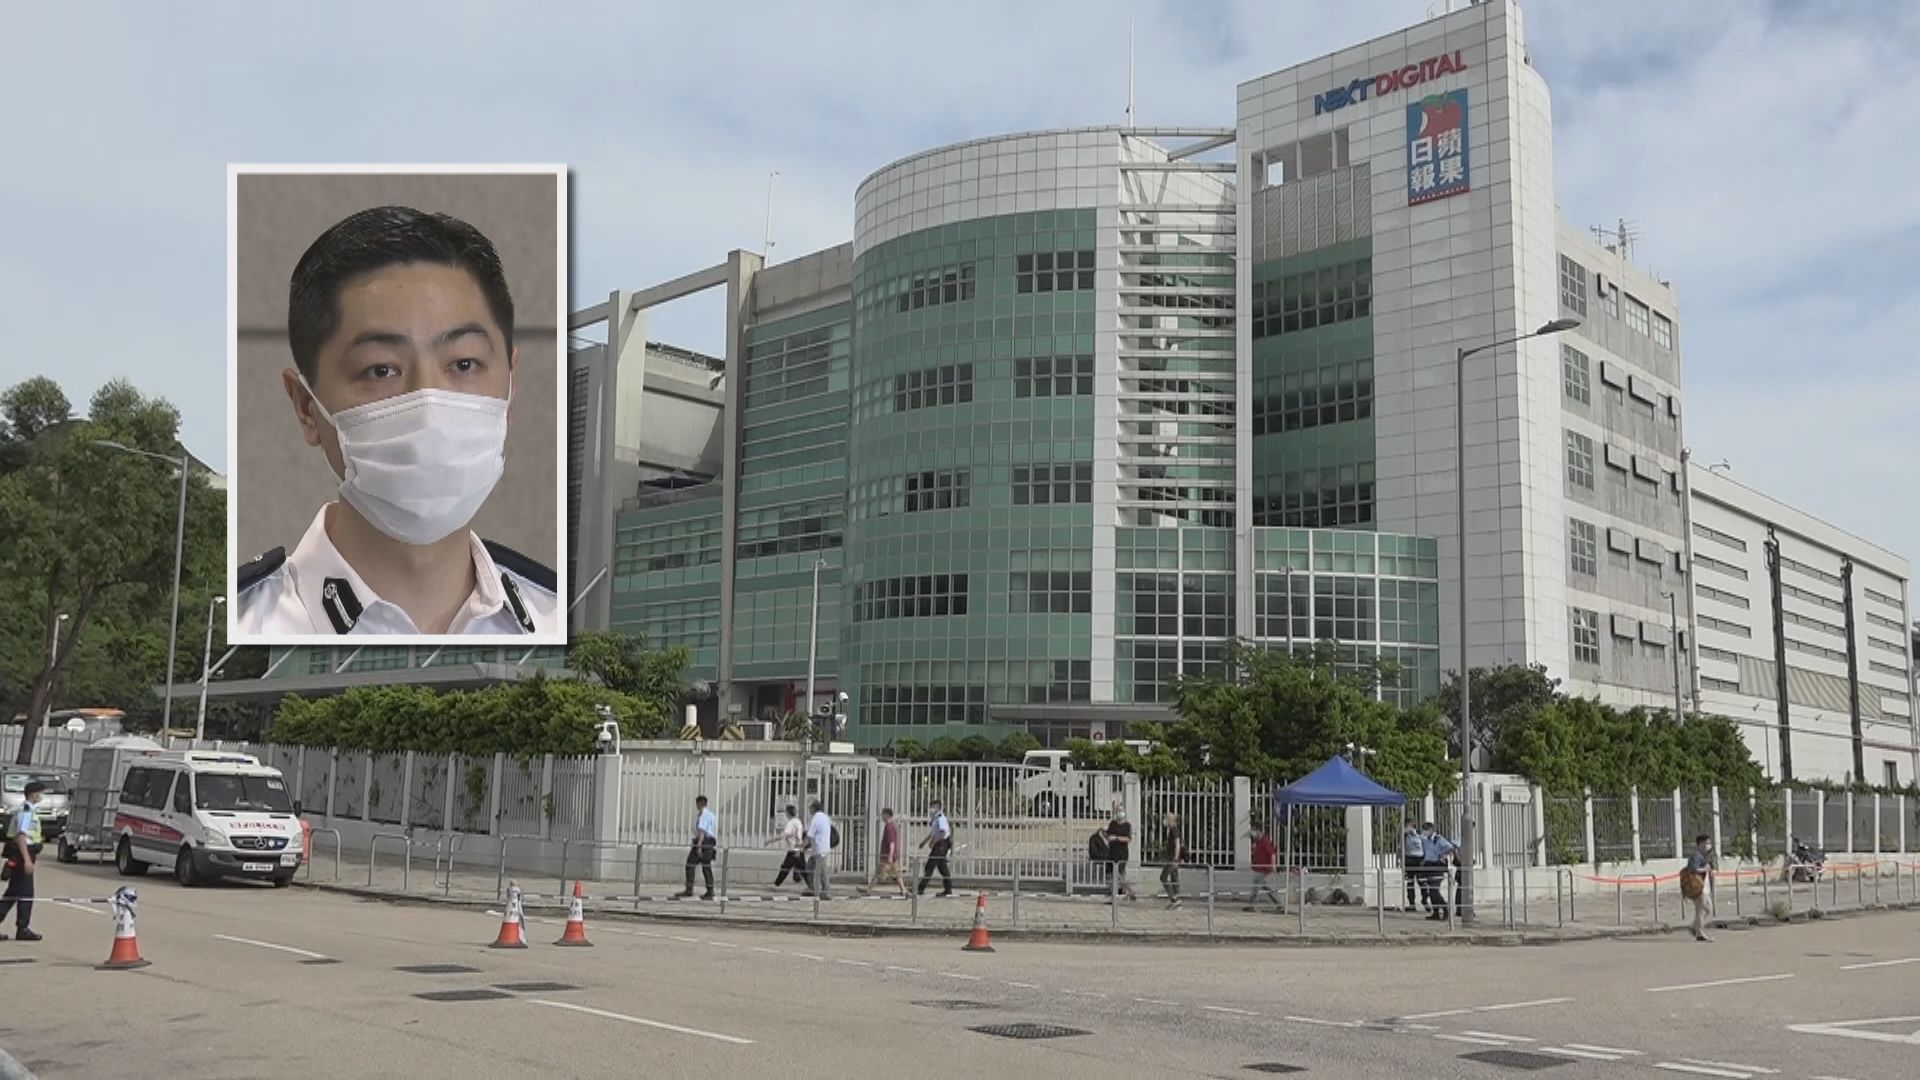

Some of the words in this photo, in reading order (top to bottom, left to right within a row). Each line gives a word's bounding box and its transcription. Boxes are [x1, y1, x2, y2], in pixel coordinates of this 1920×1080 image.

[1375, 50, 1467, 97] DIGITAL
[1410, 138, 1435, 192] 日報
[1437, 127, 1464, 185] 蘋果
